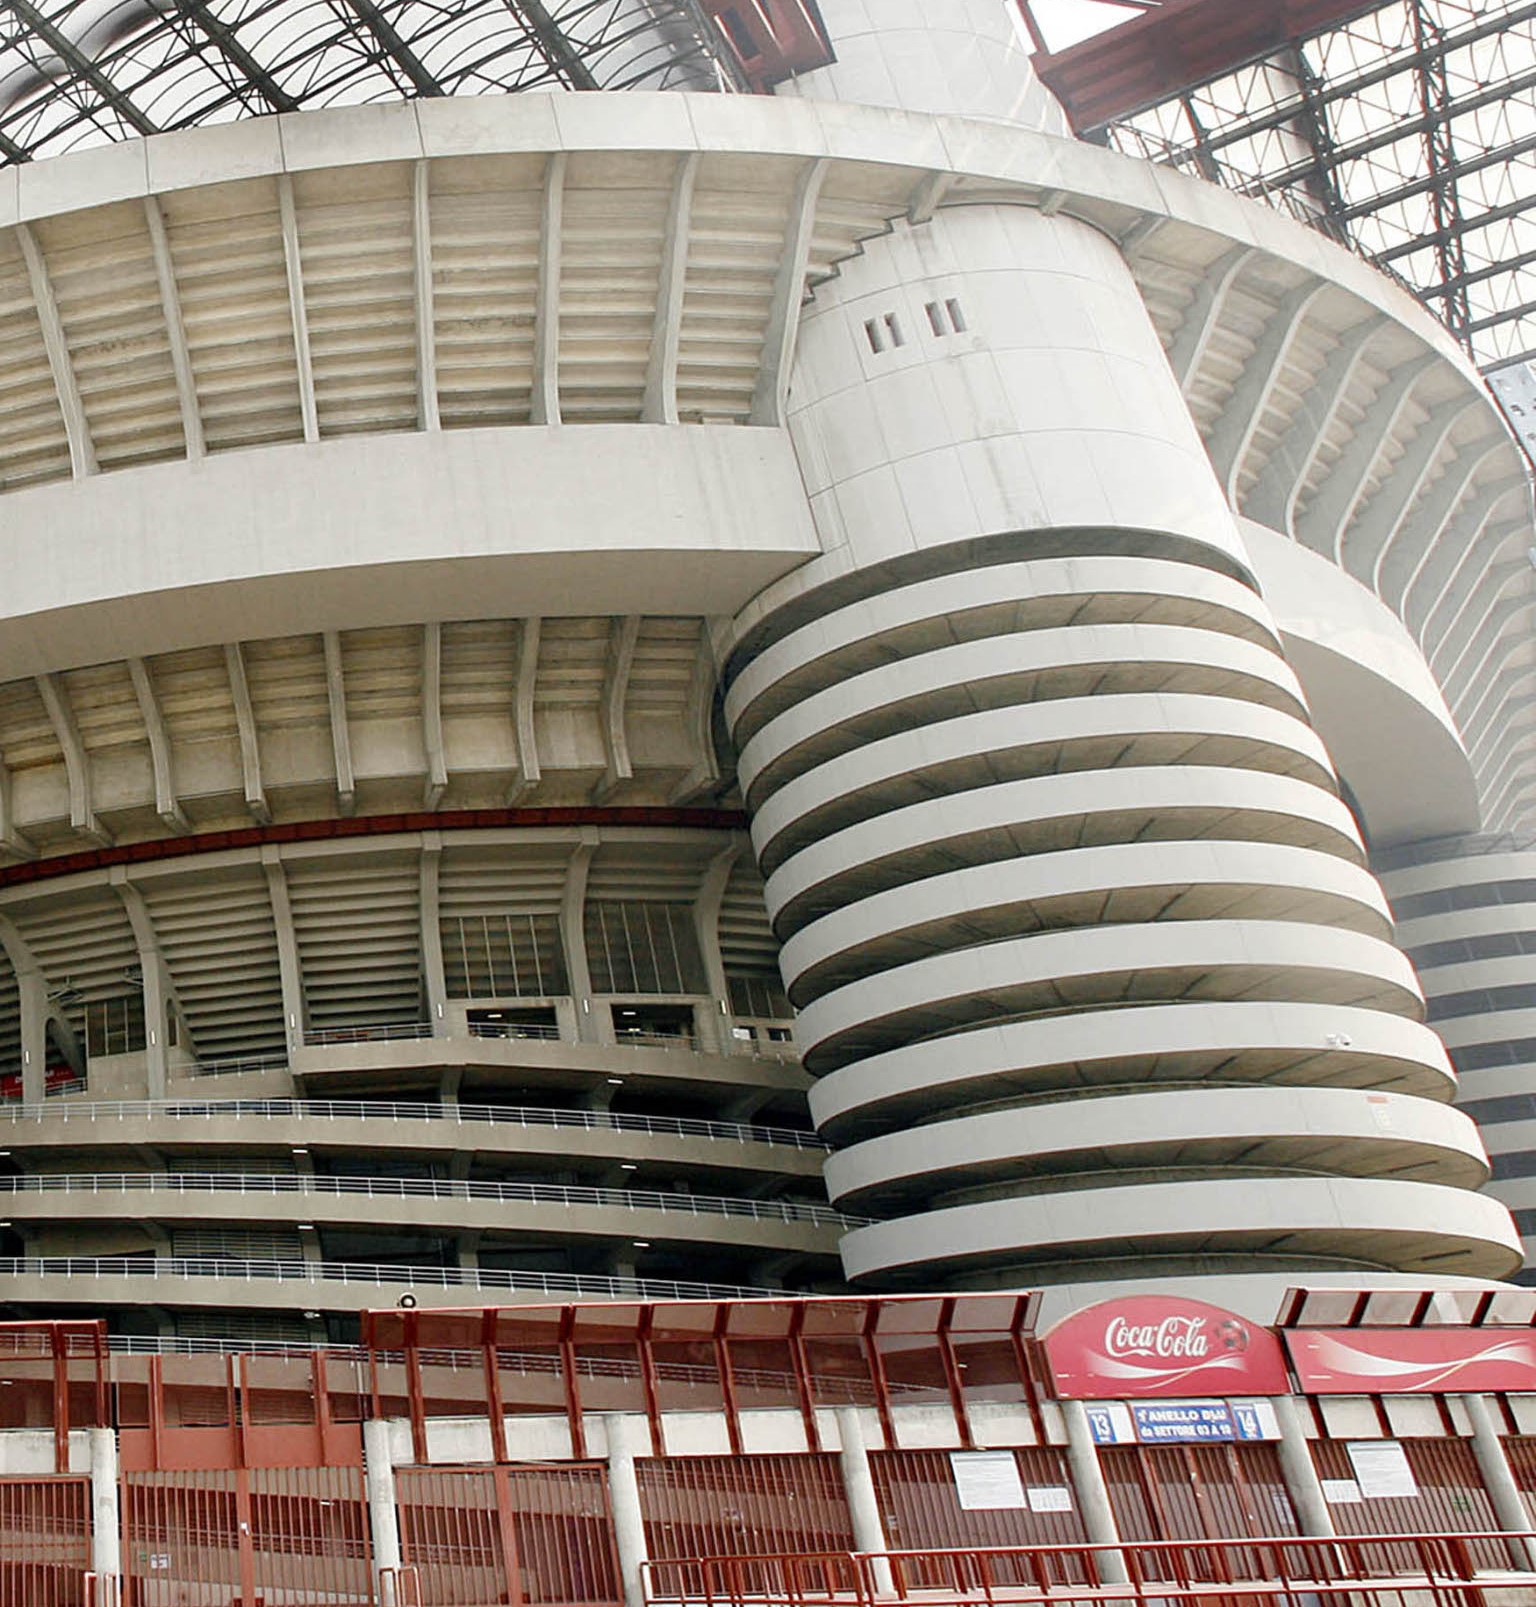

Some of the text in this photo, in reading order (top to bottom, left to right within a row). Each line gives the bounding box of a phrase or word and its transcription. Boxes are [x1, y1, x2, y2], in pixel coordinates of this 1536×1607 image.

[1105, 1316, 1209, 1358] Coca-Cola
[1091, 1414, 1110, 1436] 13
[1149, 1410, 1200, 1421] ANELLO
[1201, 1409, 1227, 1420] BLU
[1237, 1410, 1257, 1432] 14
[1154, 1425, 1197, 1437] SETTORE
